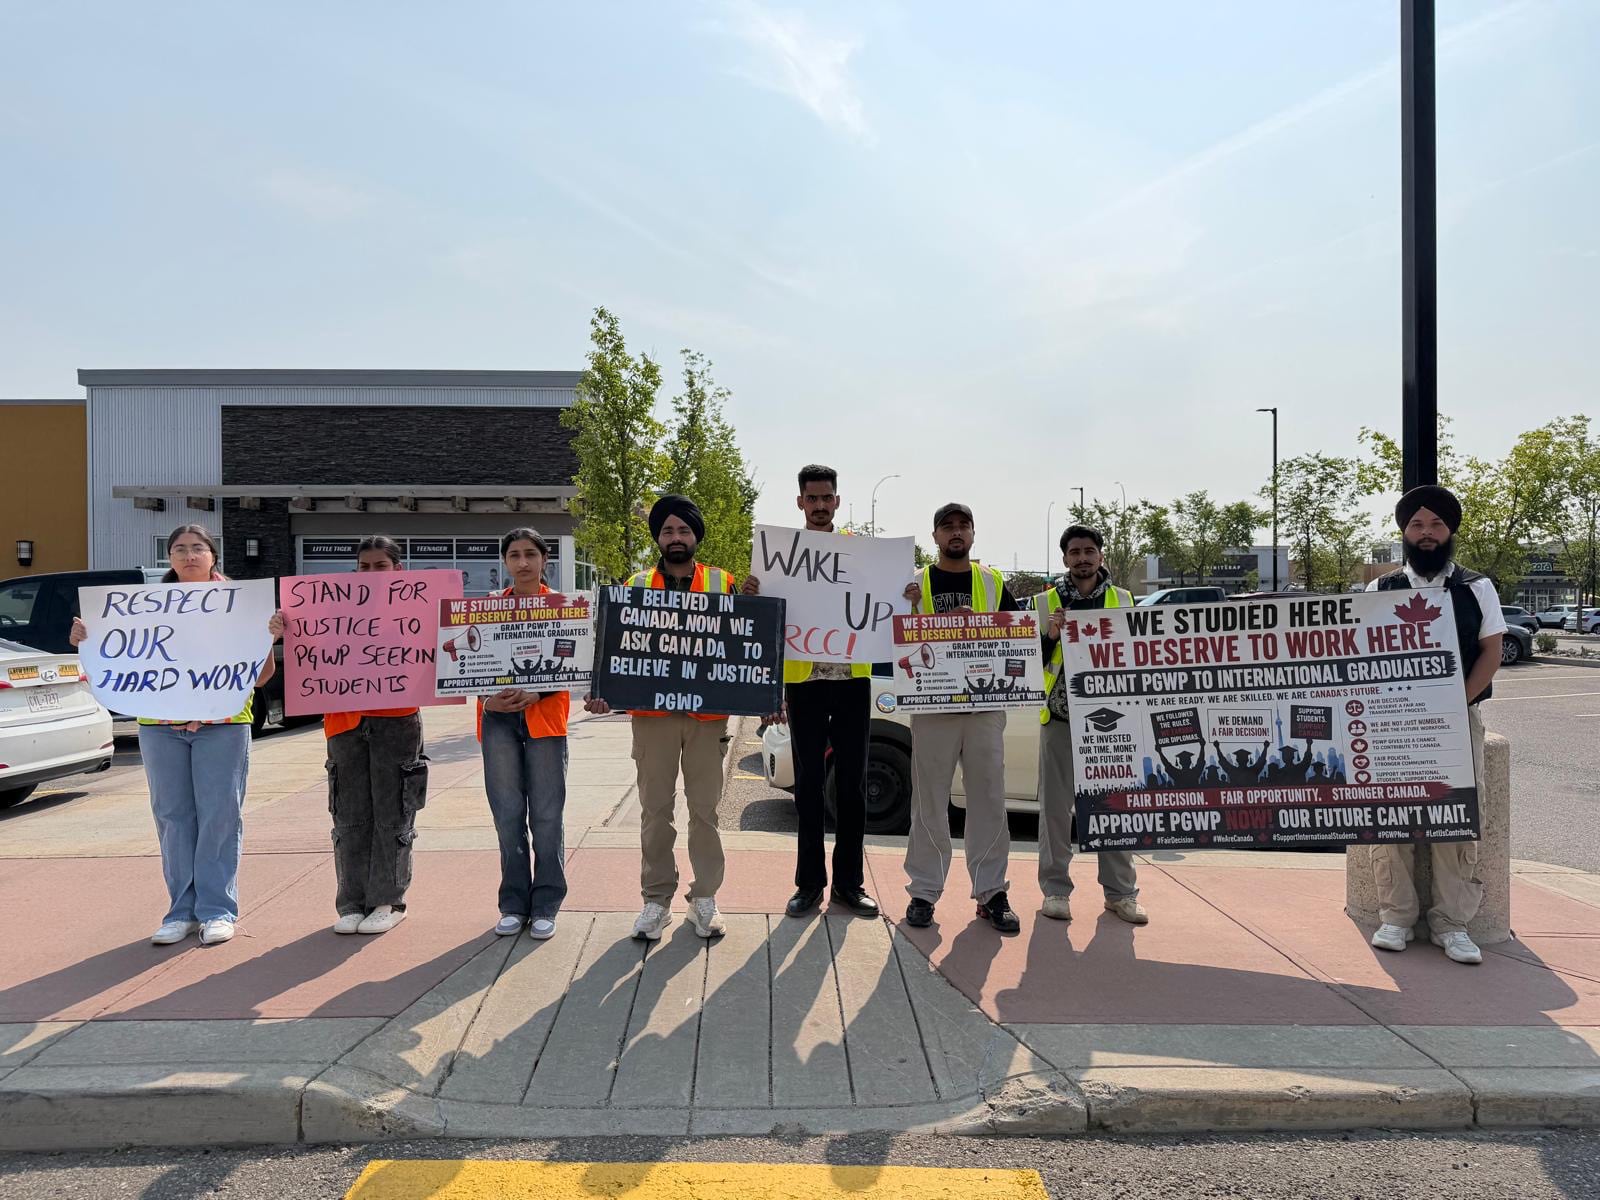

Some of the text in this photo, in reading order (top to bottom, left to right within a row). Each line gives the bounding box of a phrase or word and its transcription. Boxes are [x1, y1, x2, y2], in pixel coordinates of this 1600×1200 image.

[761, 530, 852, 584] WAKE
[102, 587, 242, 618] RESPECT
[290, 580, 428, 607] STAND FOR
[609, 586, 734, 613] WE BELIEVED IN
[451, 597, 549, 612] WE STUDIED HERE.
[845, 592, 894, 632] UP
[450, 607, 588, 624] WE DESERVE TO WORK HERE.
[902, 615, 997, 629] WE STUDIED HERE.
[1126, 598, 1360, 636] WE STUDIED HERE.
[292, 616, 420, 638] JUSTICE TO
[493, 628, 588, 641] INTERNATIONAL GRADUATES!
[500, 624, 524, 632] GRANT
[730, 618, 754, 636] WE
[903, 626, 1036, 642] WE DESERVE TO WORK HERE.
[100, 625, 177, 661] OUR
[620, 631, 762, 660] ASK CANADA TO
[784, 624, 857, 660] RCC!
[952, 642, 975, 650] GRANT
[1089, 622, 1441, 669] WE DESERVE TO WORK HERE.
[294, 644, 435, 670] PGWP SEEKIN
[946, 648, 1036, 659] INTERNATIONAL GRADUATES!
[97, 667, 180, 692] HARD
[187, 658, 264, 692] WORK
[610, 656, 776, 685] BELIEVE IN JUSTICE.
[1083, 655, 1447, 695] GRANT PGWP TO INTERNATIONAL GRADUATES!
[301, 675, 408, 696] STUDENTS
[443, 678, 473, 688] APPROVE
[475, 677, 495, 686] PGWP
[496, 676, 513, 685] NOW!
[516, 675, 528, 683] OUR
[530, 674, 553, 682] FUTURE
[555, 672, 573, 681] CAN'T
[654, 693, 703, 711] PGWP
[903, 692, 1044, 704] APPROVE PGWP NOW! OUR FUTURE CAN'T WAIT.
[1178, 697, 1205, 705] READY.
[1208, 696, 1220, 704] WE
[1240, 694, 1274, 702] SKILLED.
[1310, 689, 1348, 698] CANADA'S
[1350, 687, 1382, 696] FUTURE.
[1156, 710, 1193, 722] WE FOLLOWED
[1160, 719, 1192, 729] THE RULES.
[1218, 716, 1263, 725] WE DEMAND
[1096, 734, 1131, 743] INVESTED
[1170, 734, 1200, 743] DIPLOMAS.
[1212, 727, 1269, 736] A FAIR DECISION!
[1079, 746, 1092, 755] OUR
[1114, 744, 1136, 753] MONEY
[1085, 756, 1098, 764] AND
[1085, 764, 1137, 780] CANADA.
[1126, 785, 1430, 808] FAIR DECISION. FAIR OPPORTUNITY. STRONGER CANADA.
[1088, 804, 1471, 835] APPROVE PGWP NOW! OUR FUTURE CAN'T WAIT.
[1104, 829, 1473, 846] #GrantPGWP #FairDecision #WeAreCanada #SupportInternationalStudents #PGWPNow #LetUsContribute
